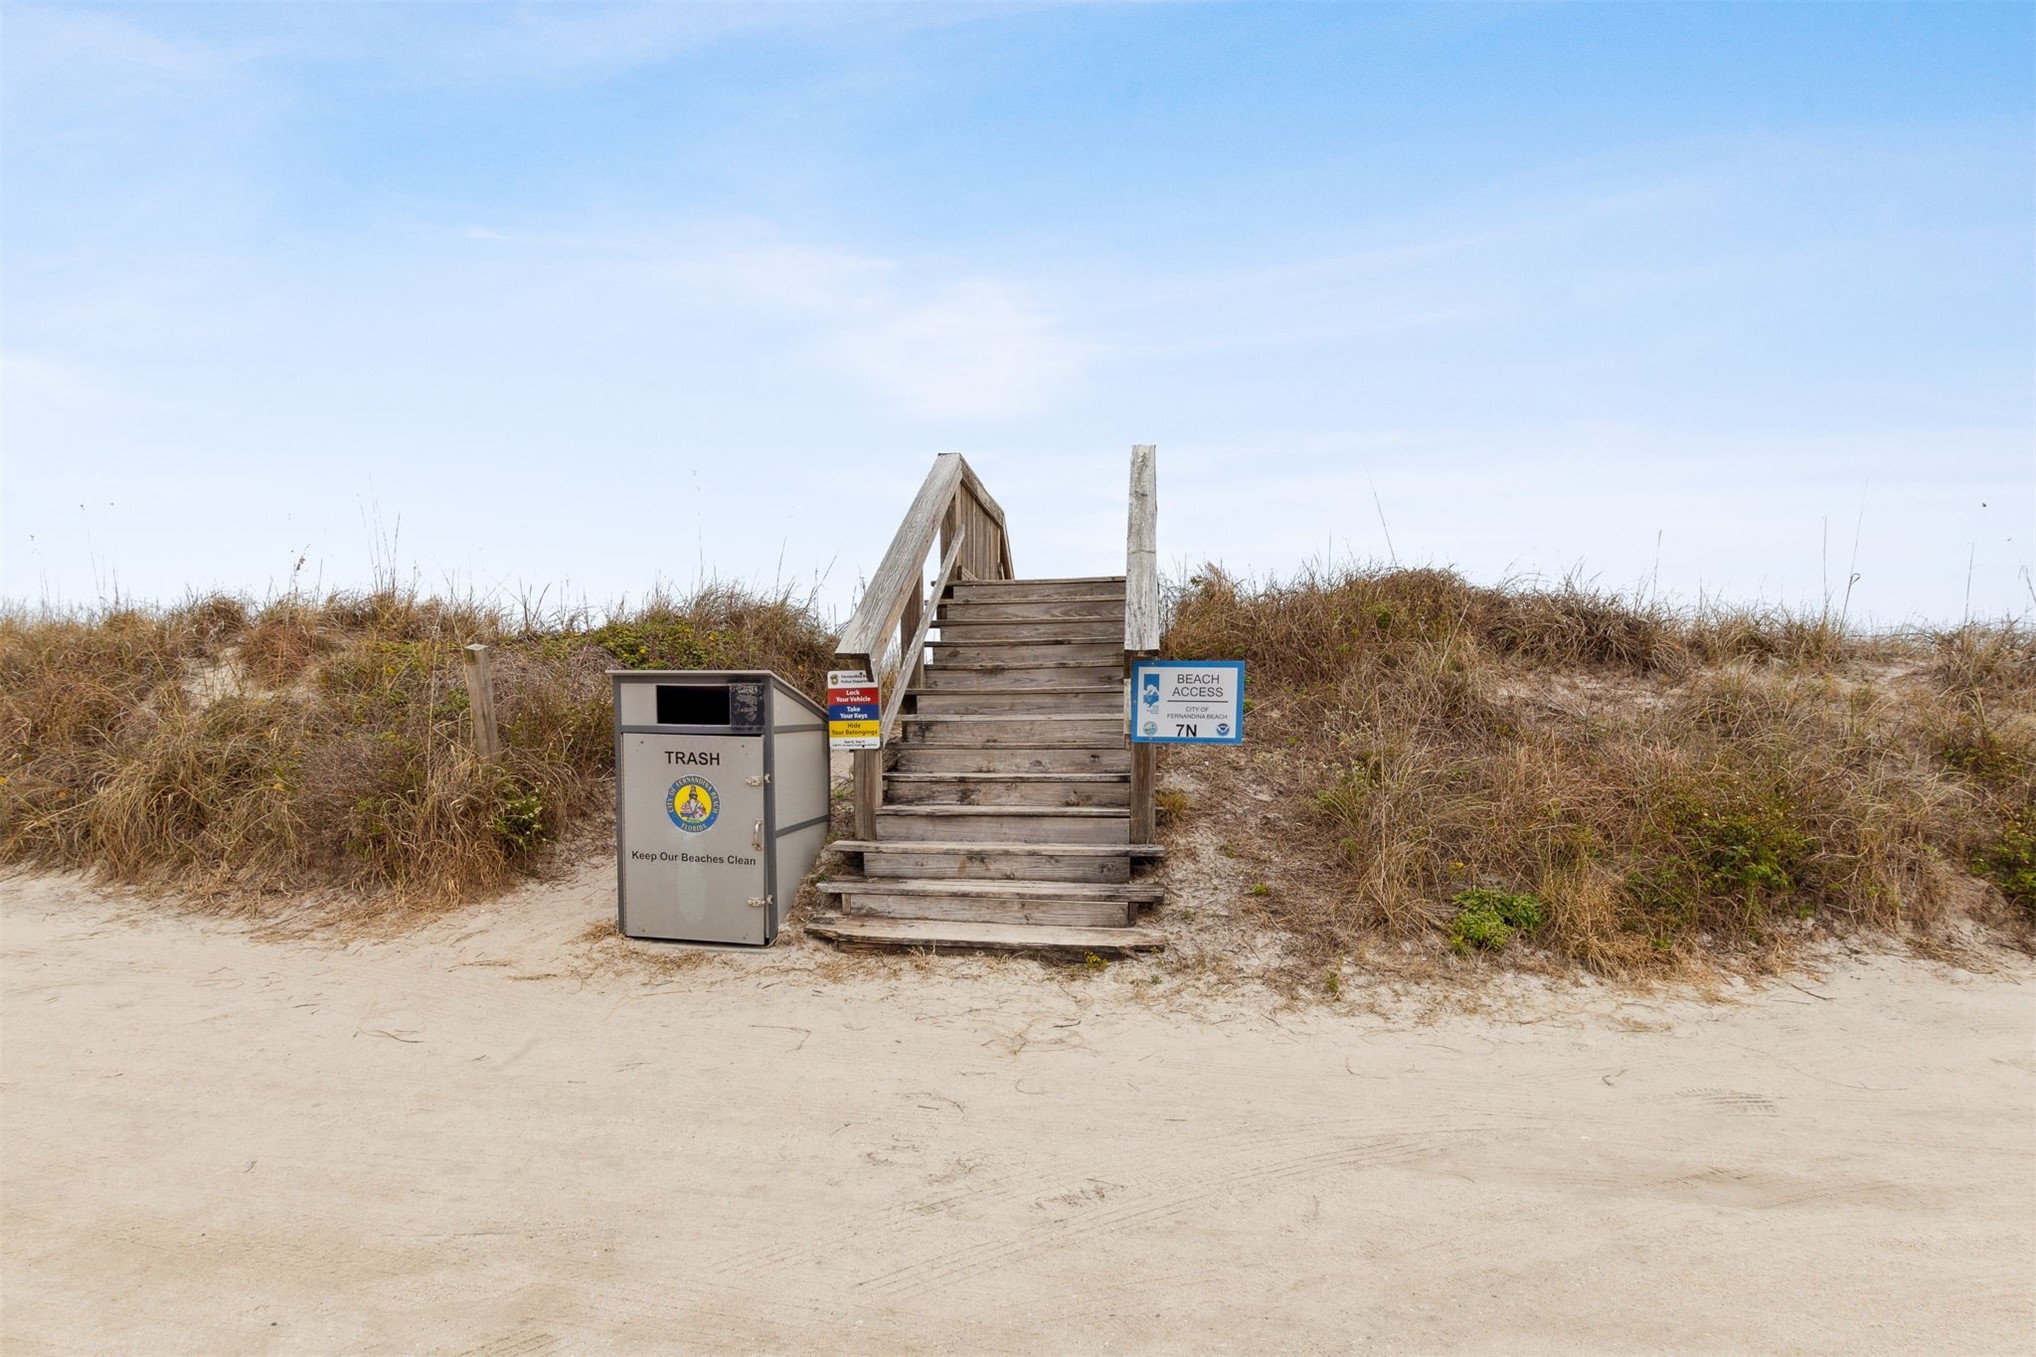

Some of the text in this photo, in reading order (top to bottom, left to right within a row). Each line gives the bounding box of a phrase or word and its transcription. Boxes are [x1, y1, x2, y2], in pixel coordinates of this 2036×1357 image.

[1177, 674, 1220, 684] BEACH
[1172, 687, 1224, 697] ACCESS
[1176, 724, 1197, 737] 7N
[665, 751, 720, 766] TRASH
[681, 823, 707, 832] FLORIDA
[632, 851, 756, 865] Keep Our Beaches Clean
